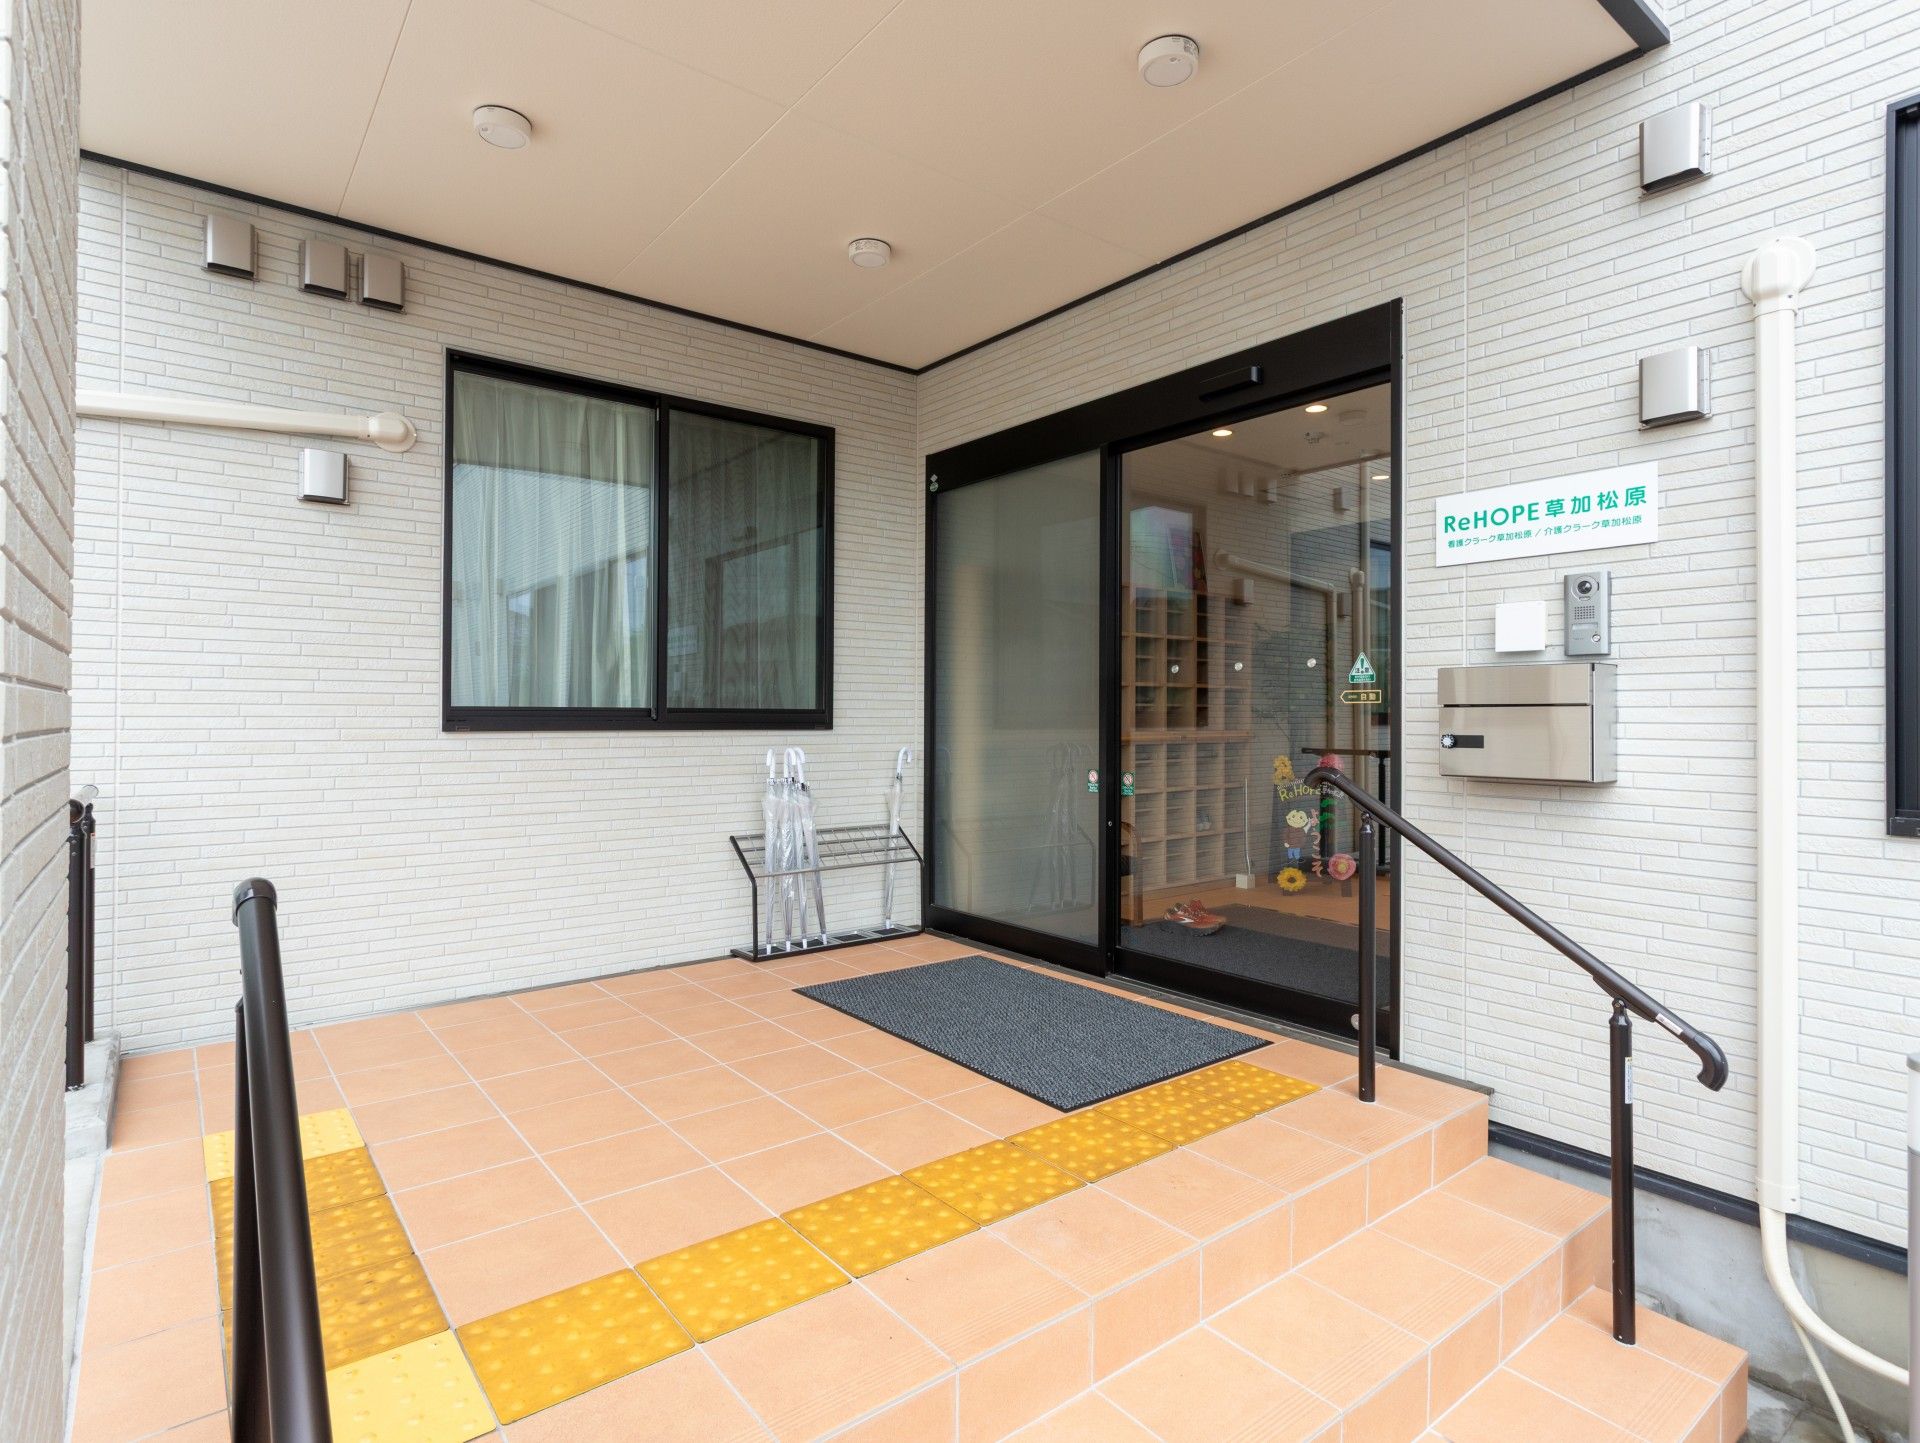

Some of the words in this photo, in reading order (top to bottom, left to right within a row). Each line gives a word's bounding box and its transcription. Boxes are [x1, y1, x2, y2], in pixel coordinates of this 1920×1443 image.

[1443, 502, 1540, 534] ReHOPE
[1544, 485, 1648, 518] 草加松原
[1447, 529, 1533, 549] 看護クラーク草加松原
[1543, 514, 1642, 536] 介護クラーク草加松原
